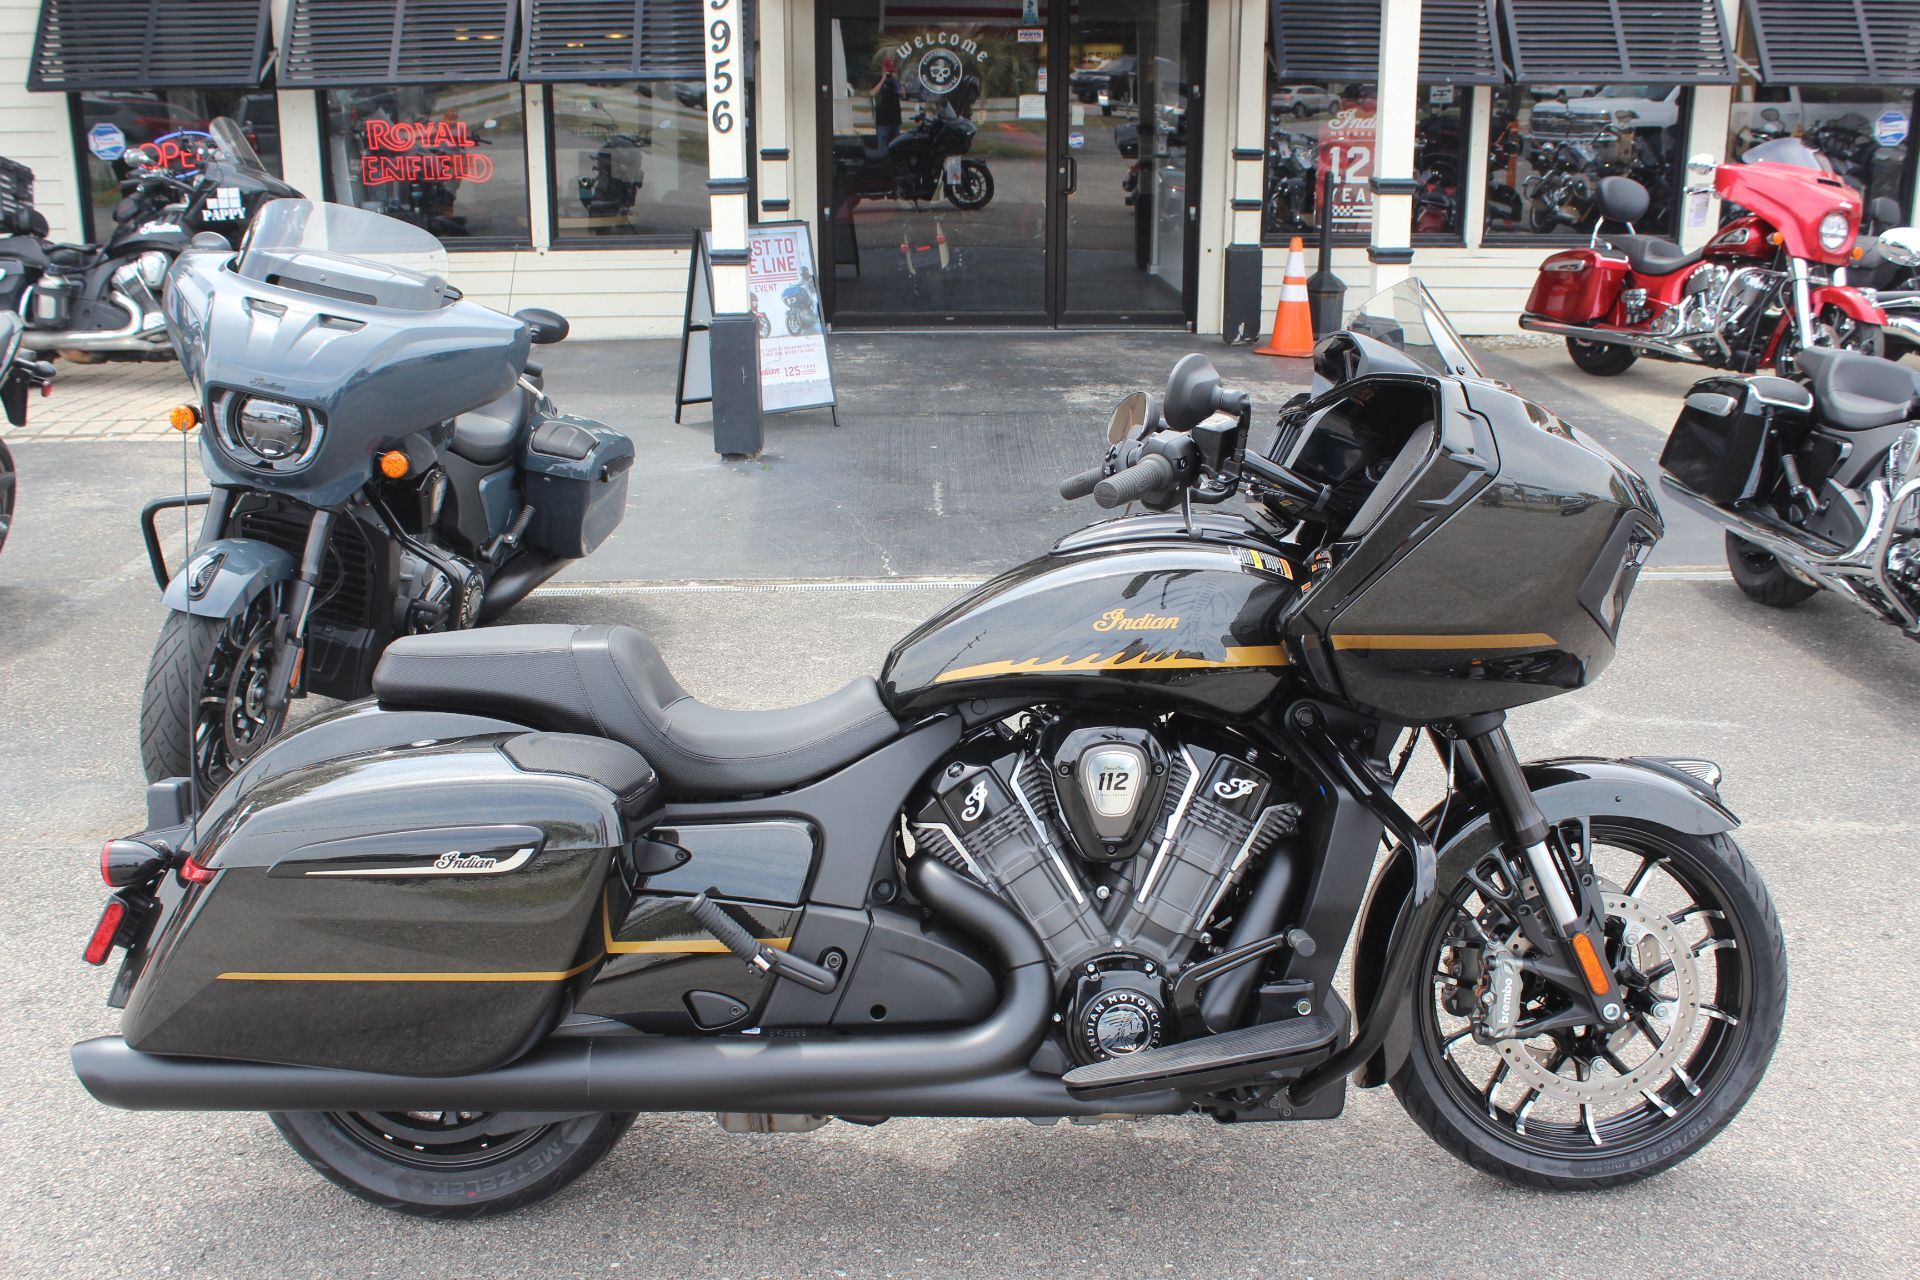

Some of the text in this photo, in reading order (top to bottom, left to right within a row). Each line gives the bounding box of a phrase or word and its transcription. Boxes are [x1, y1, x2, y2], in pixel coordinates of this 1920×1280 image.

[366, 119, 476, 151] ROYAL
[139, 142, 206, 170] OPE
[361, 154, 494, 186] ENFIELD
[202, 207, 246, 222] PAPPY
[774, 238, 795, 255] TO
[762, 256, 798, 274] LINE
[755, 284, 777, 293] EVENT
[784, 365, 801, 377] 125
[1092, 608, 1180, 632] Indian
[1098, 772, 1129, 791] 112
[435, 852, 495, 870] Indian
[1498, 977, 1514, 1024] brembo
[1086, 1003, 1105, 1053] INDIAN
[432, 1141, 563, 1196] METZELER
